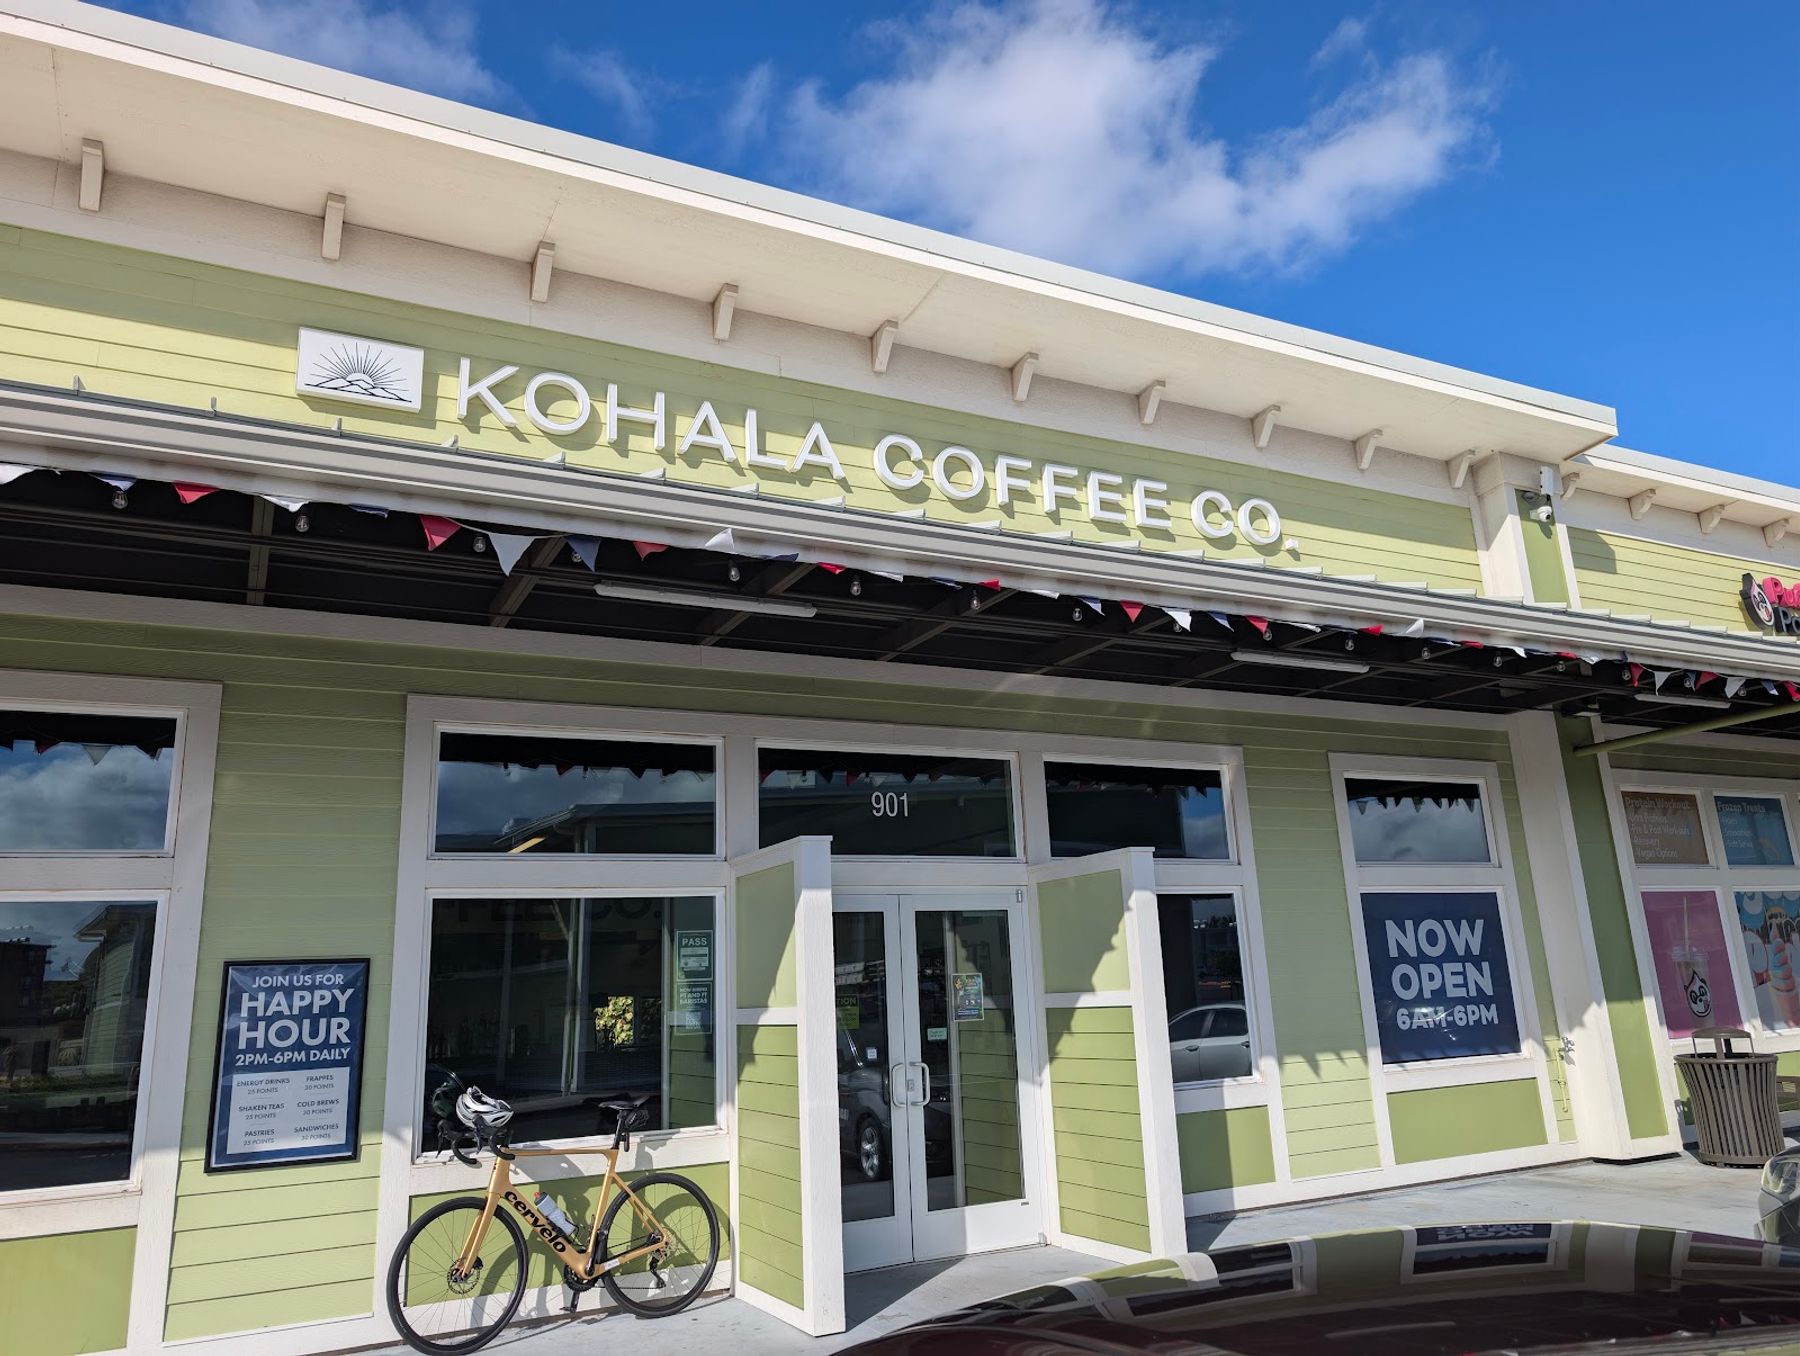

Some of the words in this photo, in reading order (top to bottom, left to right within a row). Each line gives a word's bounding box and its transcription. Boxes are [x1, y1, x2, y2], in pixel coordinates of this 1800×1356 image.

[457, 356, 846, 480] KOHALA
[873, 434, 1173, 529] COFFEE
[1190, 489, 1299, 550] CO.
[871, 791, 909, 817] 901
[682, 937, 707, 946] PASS
[1385, 919, 1484, 957] NOW
[252, 975, 289, 988] JOIN
[293, 975, 312, 986] US
[315, 974, 344, 985] FOR
[1392, 961, 1493, 1000] OPEN
[240, 988, 355, 1018] HAPPY
[1396, 1004, 1499, 1030] 6AM-6PM
[238, 1017, 351, 1050] HOUR
[235, 1051, 306, 1066] 2PM-6PM
[310, 1048, 351, 1061] DAILY
[237, 1079, 264, 1087] ENERGY
[306, 1074, 334, 1082] FRAPPES
[239, 1104, 267, 1112] SHAKEN
[244, 1129, 275, 1137] PASTRIES
[294, 1123, 339, 1133] SANDWICHES
